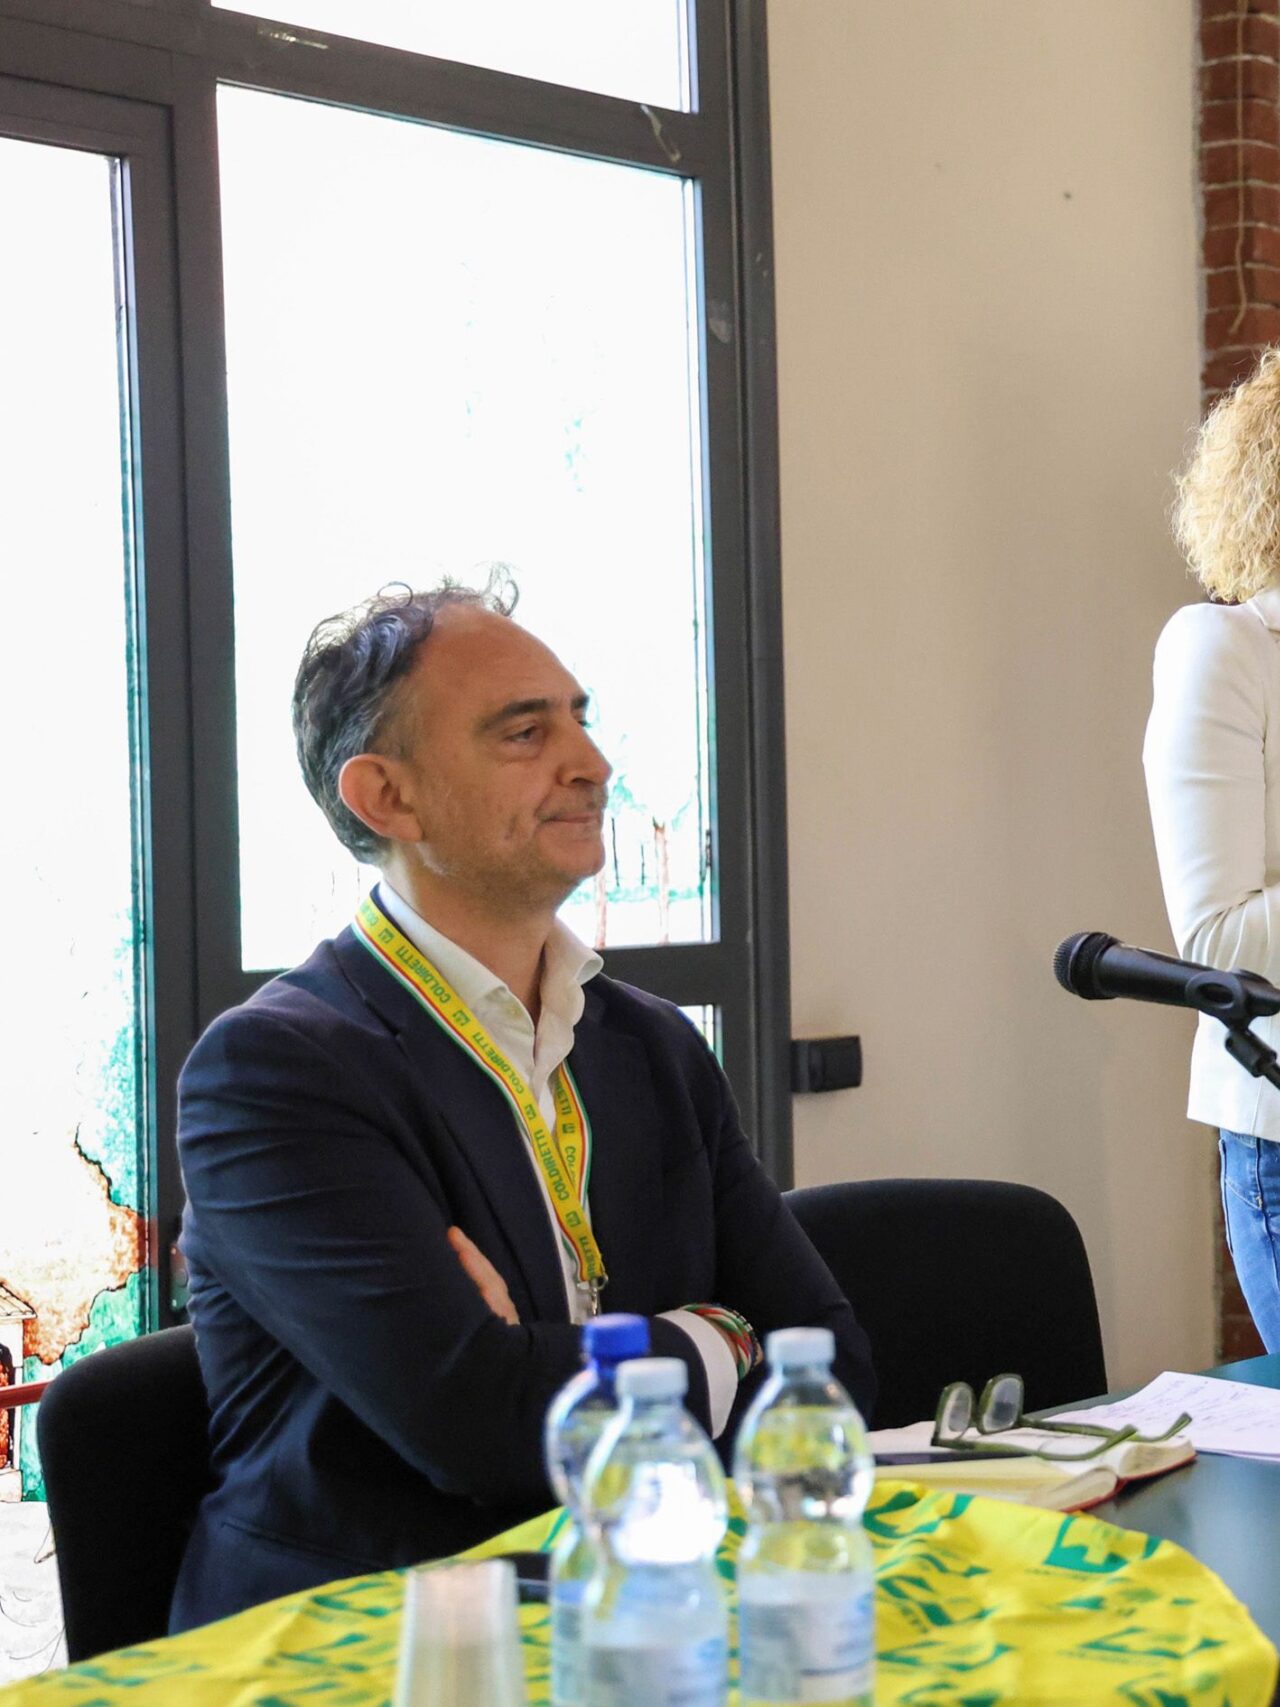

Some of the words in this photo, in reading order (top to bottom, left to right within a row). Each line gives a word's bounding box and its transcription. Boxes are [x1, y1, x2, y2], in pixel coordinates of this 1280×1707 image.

[395, 945, 451, 1004] COLDIRETTI
[472, 1031, 525, 1095] COLDIRETTI
[533, 1128, 570, 1201] COLDIRETTI
